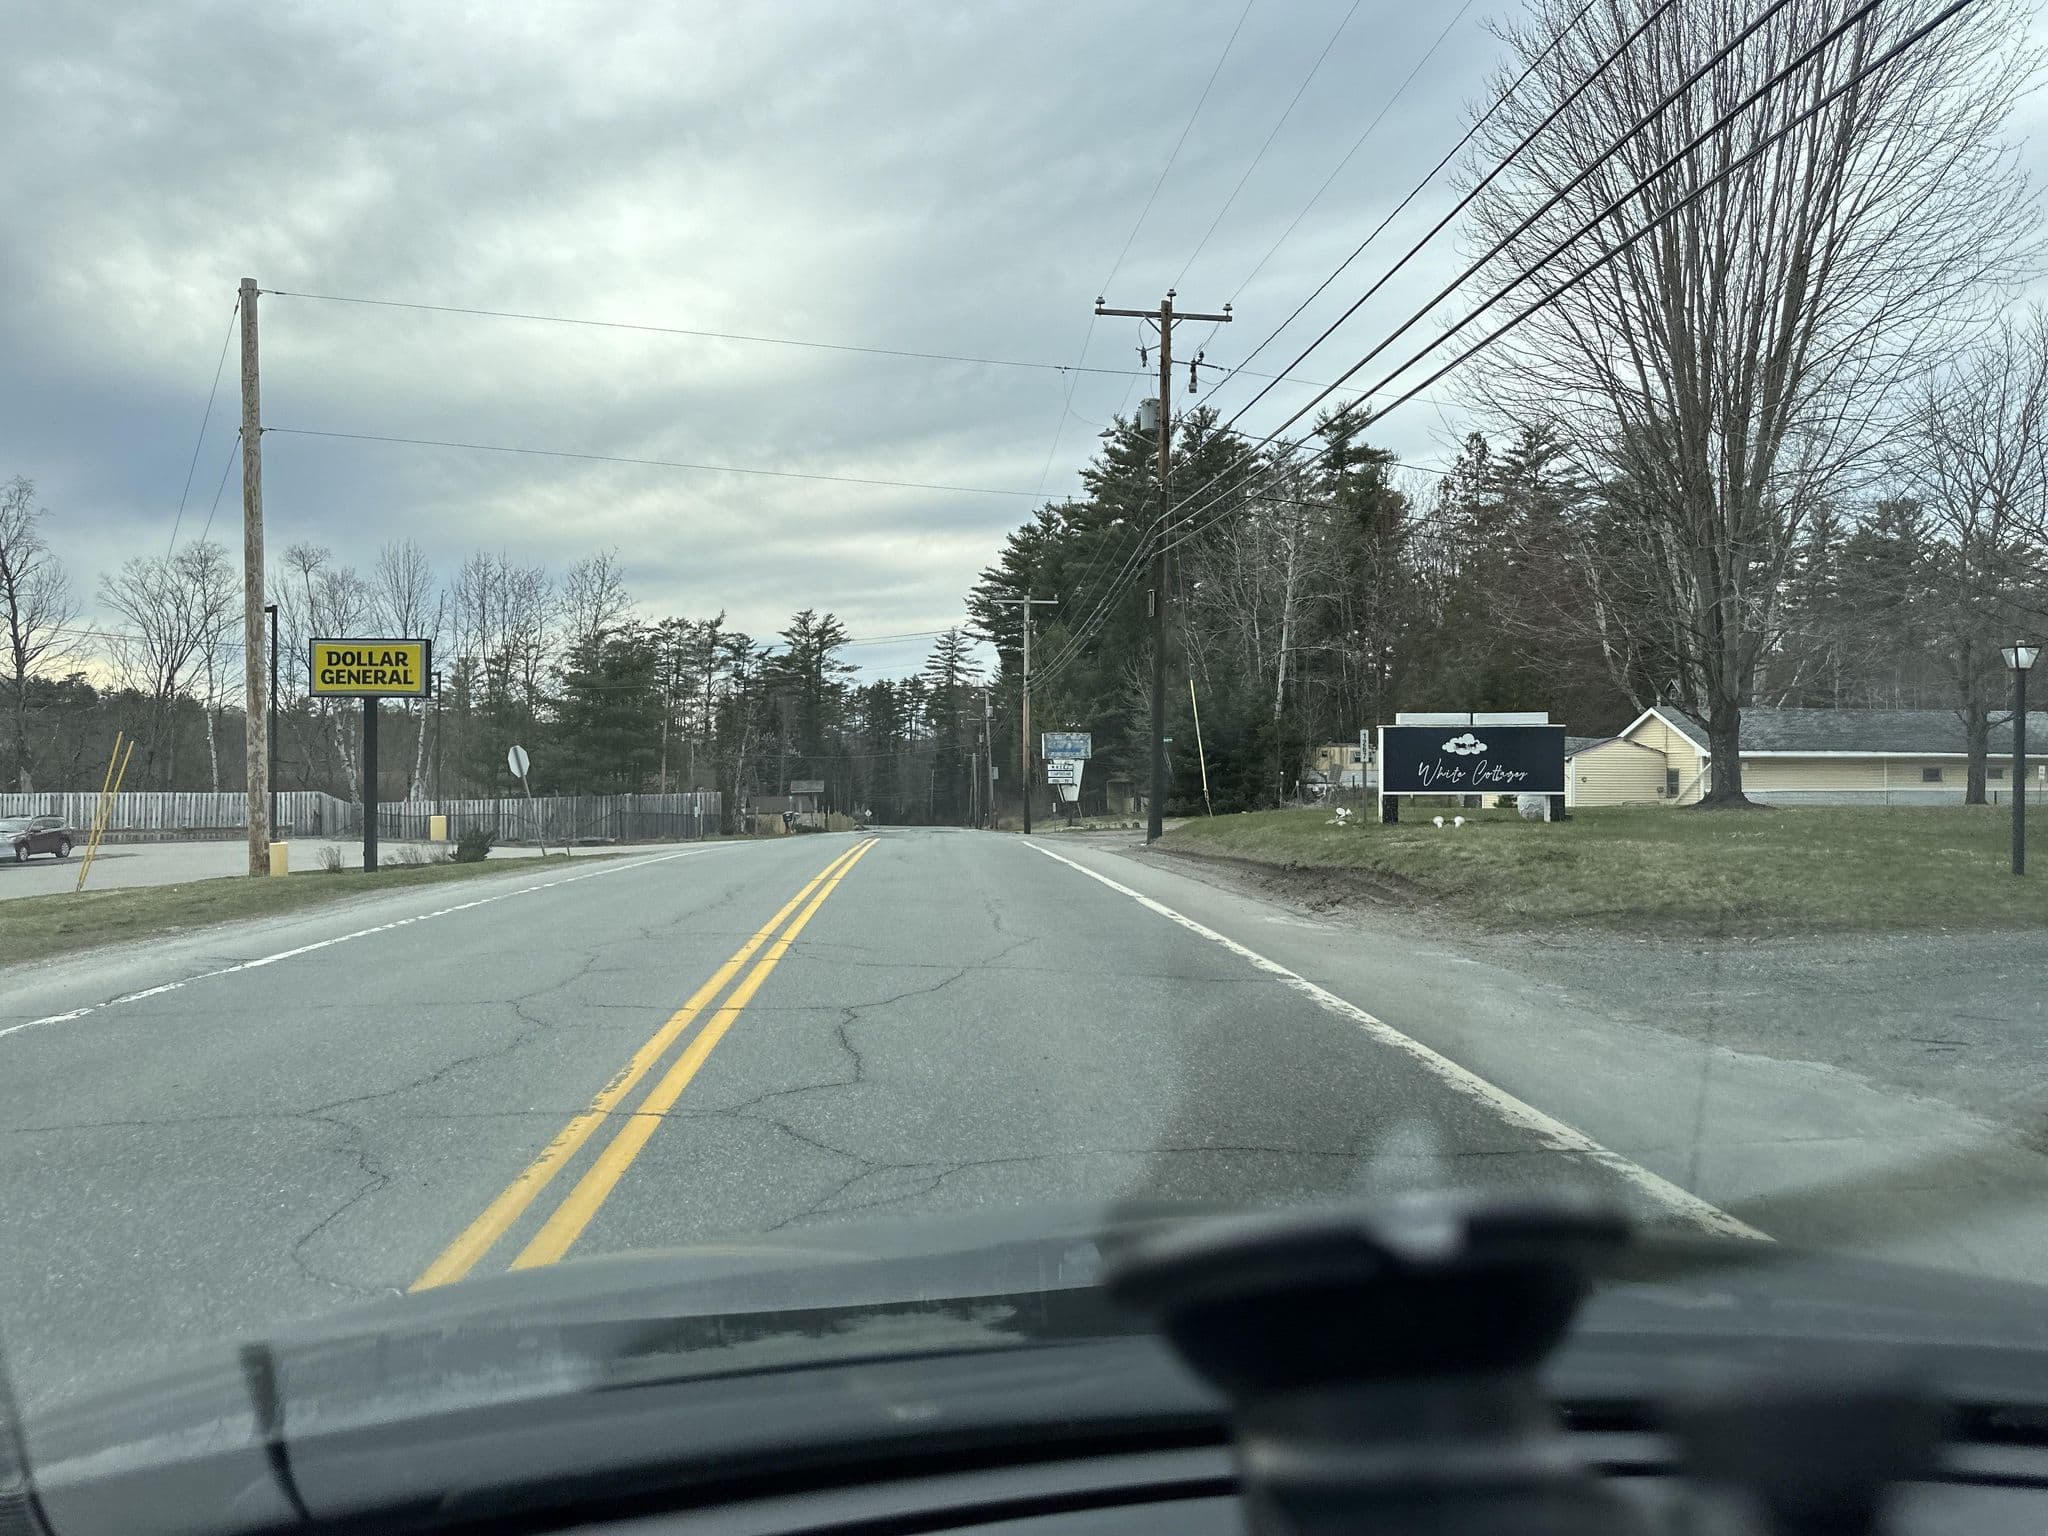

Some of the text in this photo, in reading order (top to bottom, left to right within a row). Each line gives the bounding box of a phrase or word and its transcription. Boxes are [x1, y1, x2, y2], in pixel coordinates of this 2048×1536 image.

[326, 651, 408, 667] DOLLAR
[320, 669, 414, 685] GENERAL
[1418, 758, 1528, 787] White Cottages
